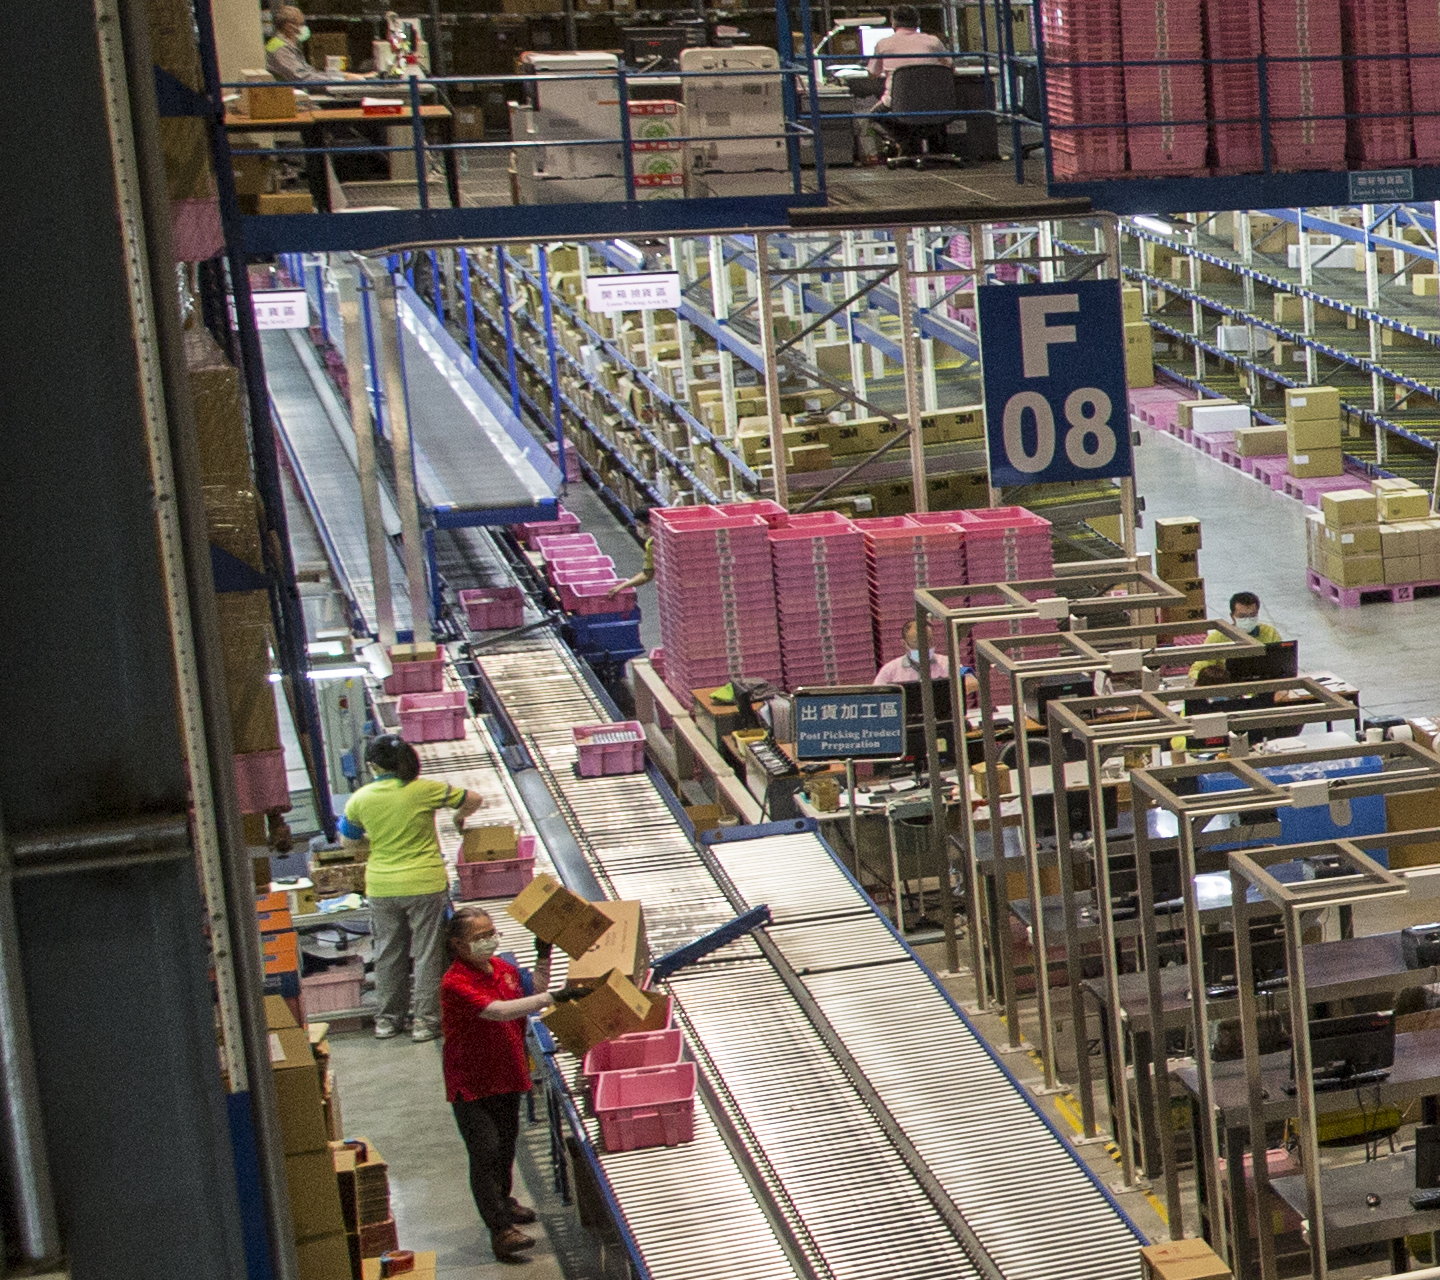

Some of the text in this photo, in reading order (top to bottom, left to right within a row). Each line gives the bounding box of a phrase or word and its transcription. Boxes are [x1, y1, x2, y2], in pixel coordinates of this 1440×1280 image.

[1019, 293, 1080, 378] F
[955, 413, 974, 425] 3M
[840, 427, 858, 439] 3M
[879, 423, 898, 434] 3M
[1002, 387, 1117, 473] 08
[801, 432, 819, 443] 3M
[1182, 525, 1199, 535] 3M
[1178, 553, 1196, 563] 3M
[1186, 581, 1202, 591] 3M
[1187, 608, 1205, 619] 3M
[801, 701, 898, 721] 出貨加工區
[799, 729, 901, 741] Post Picking Product
[821, 740, 880, 751] Preparation
